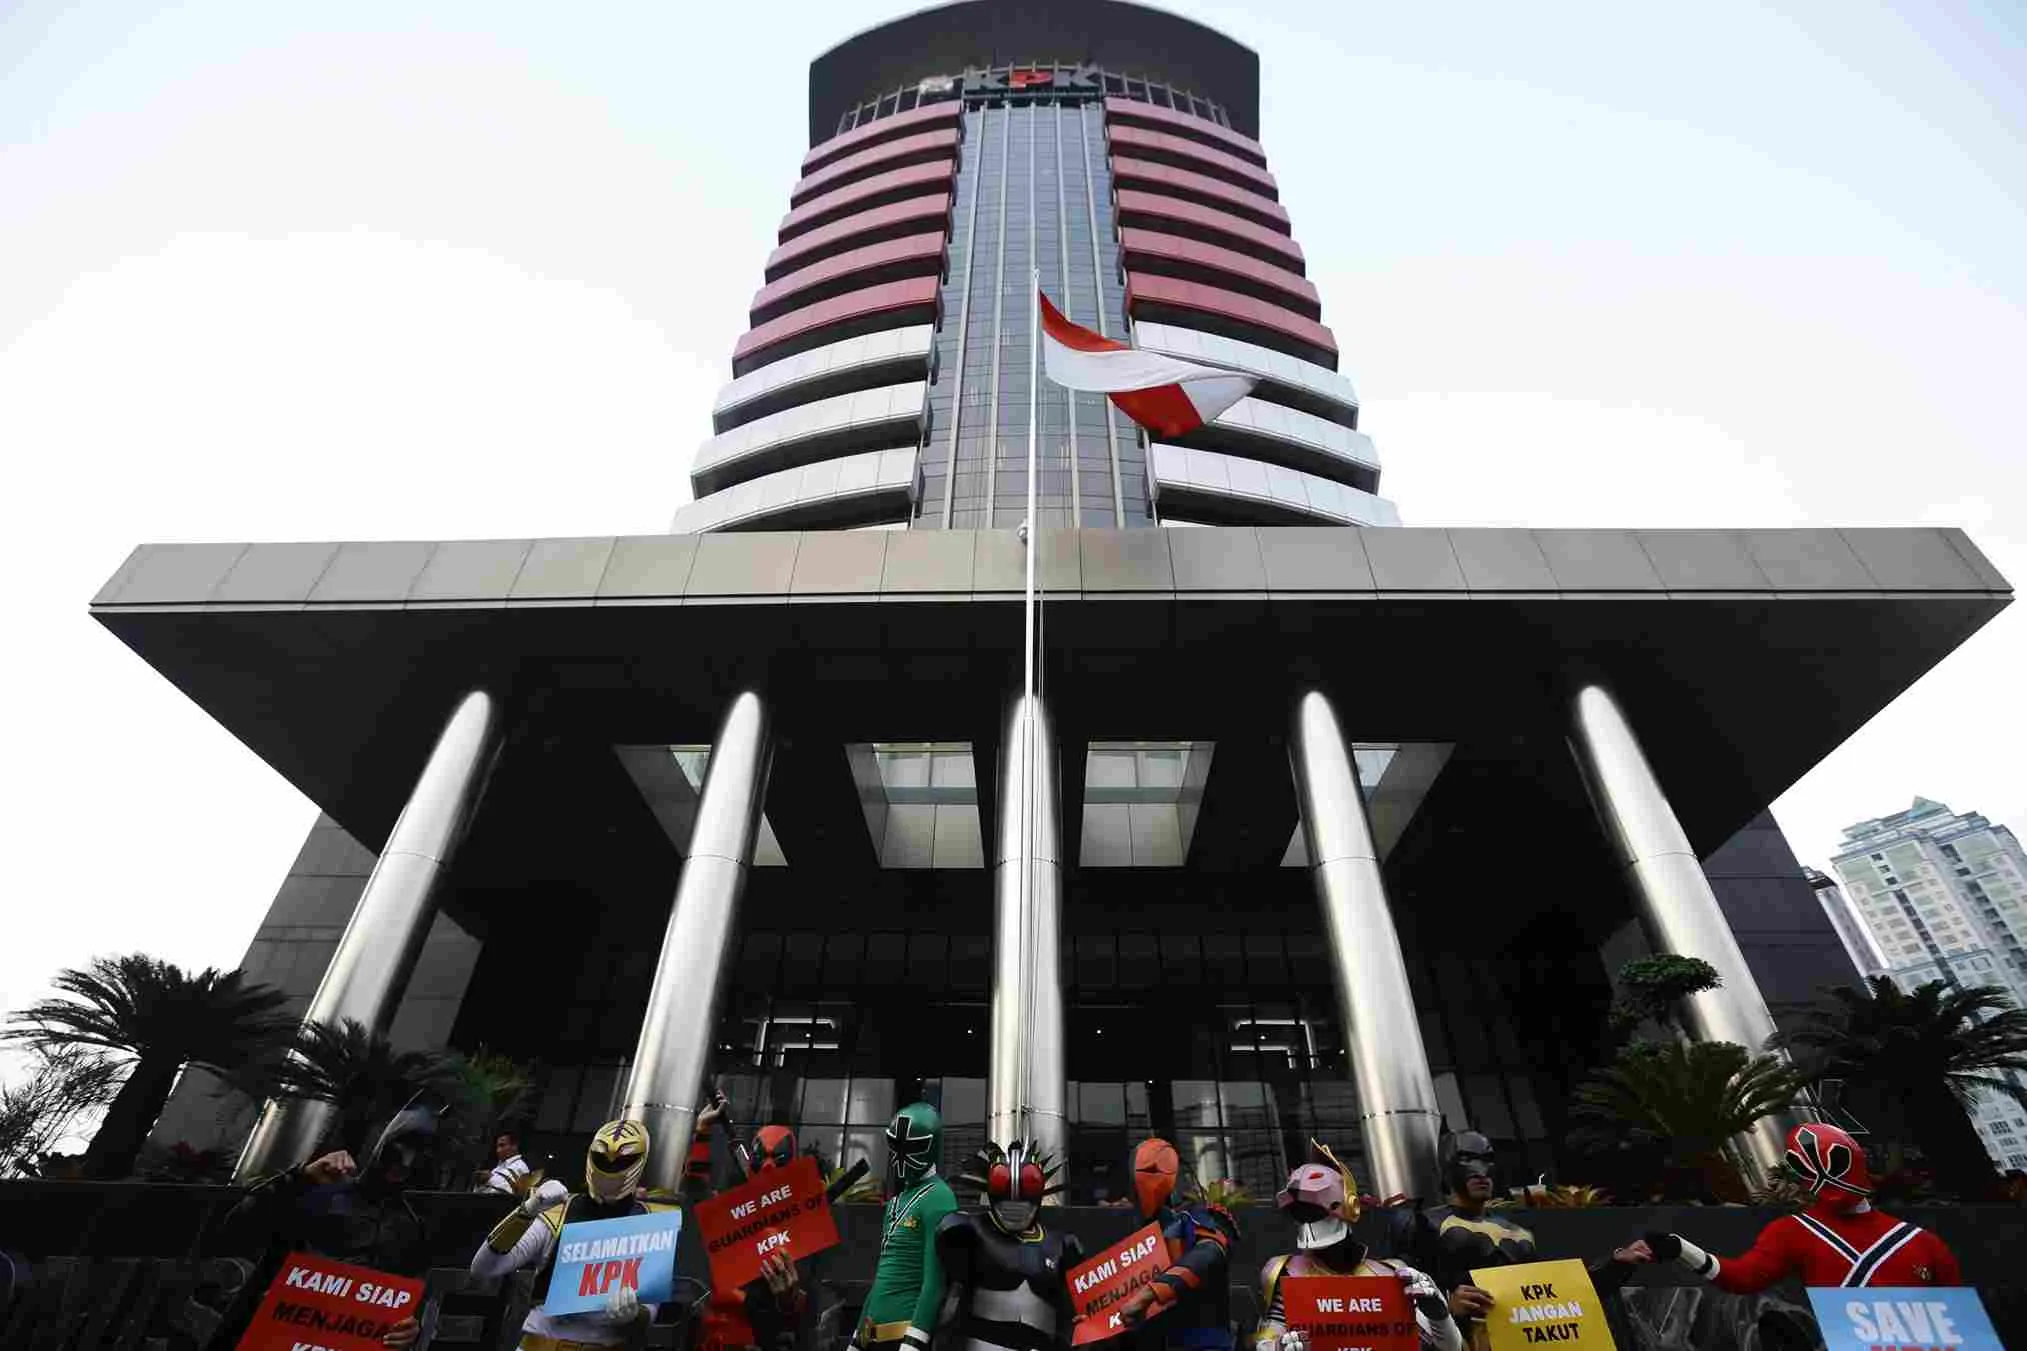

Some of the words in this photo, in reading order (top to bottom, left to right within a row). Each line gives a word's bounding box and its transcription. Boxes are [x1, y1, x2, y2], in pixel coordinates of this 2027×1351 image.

[964, 68, 1100, 91] KPK
[730, 1201, 757, 1219] WE
[760, 1185, 793, 1208] ARE
[708, 1204, 801, 1254] GUARDIANS
[756, 1230, 791, 1255] KPK
[561, 1230, 674, 1263] SELAMATKAN
[579, 1257, 643, 1296] KPK
[1074, 1258, 1118, 1294] KAMI
[1119, 1235, 1157, 1268] SIAP
[286, 1266, 353, 1297] KAMI
[355, 1282, 411, 1309] SIAP
[1086, 1264, 1163, 1315] MENJAGA
[1520, 1283, 1558, 1301] KPK
[1316, 1298, 1344, 1312] WE
[1348, 1298, 1382, 1312] ARE
[1509, 1301, 1583, 1323] JANGAN
[1522, 1323, 1579, 1343] TAKUT
[1845, 1300, 1963, 1344] SAVE
